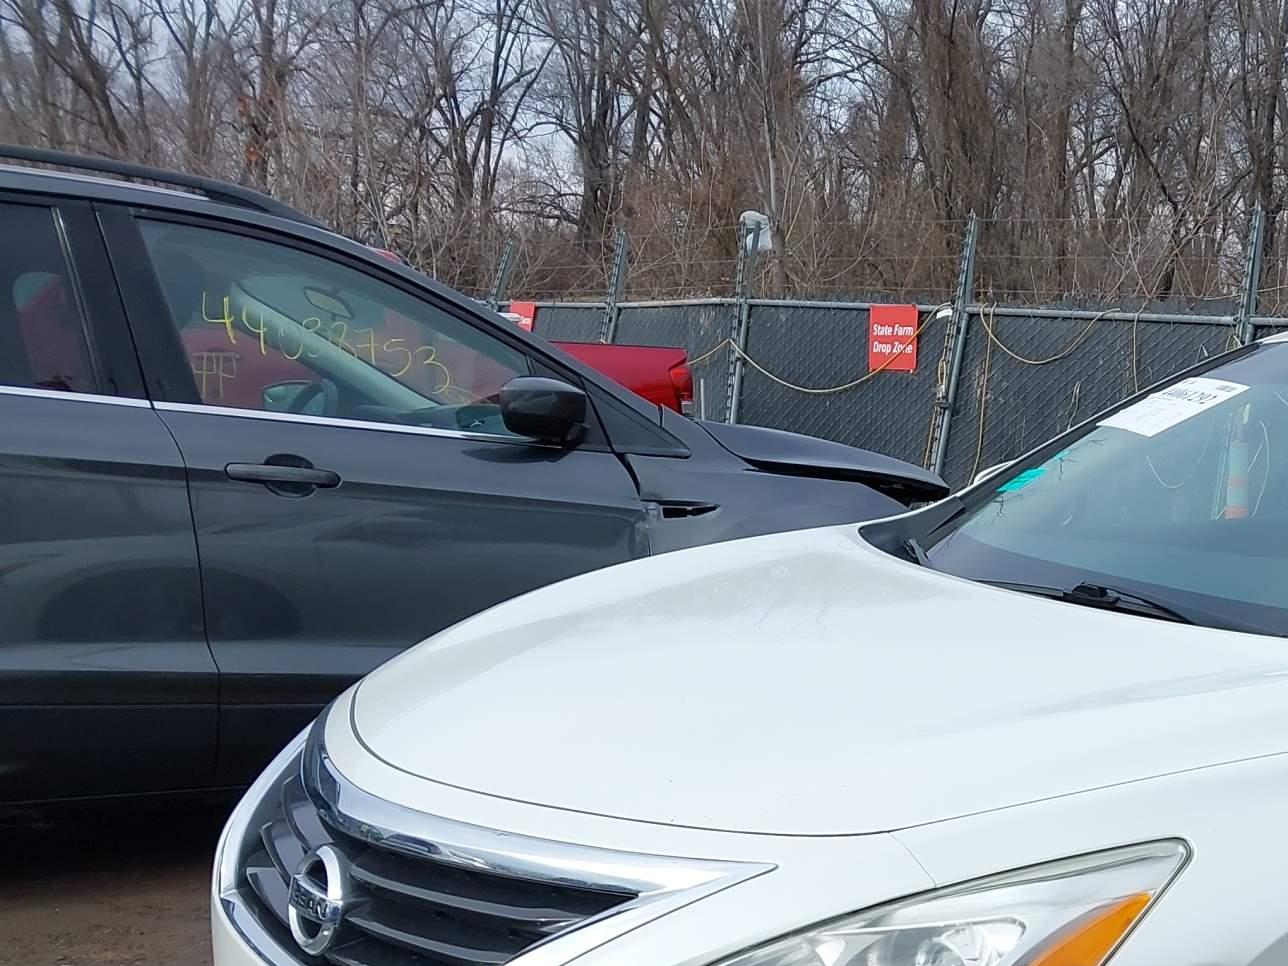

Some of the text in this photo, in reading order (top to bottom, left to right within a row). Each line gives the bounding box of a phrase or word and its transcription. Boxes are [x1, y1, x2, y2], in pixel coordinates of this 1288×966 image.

[873, 324, 914, 336] State Farm
[873, 341, 892, 356] Drop
